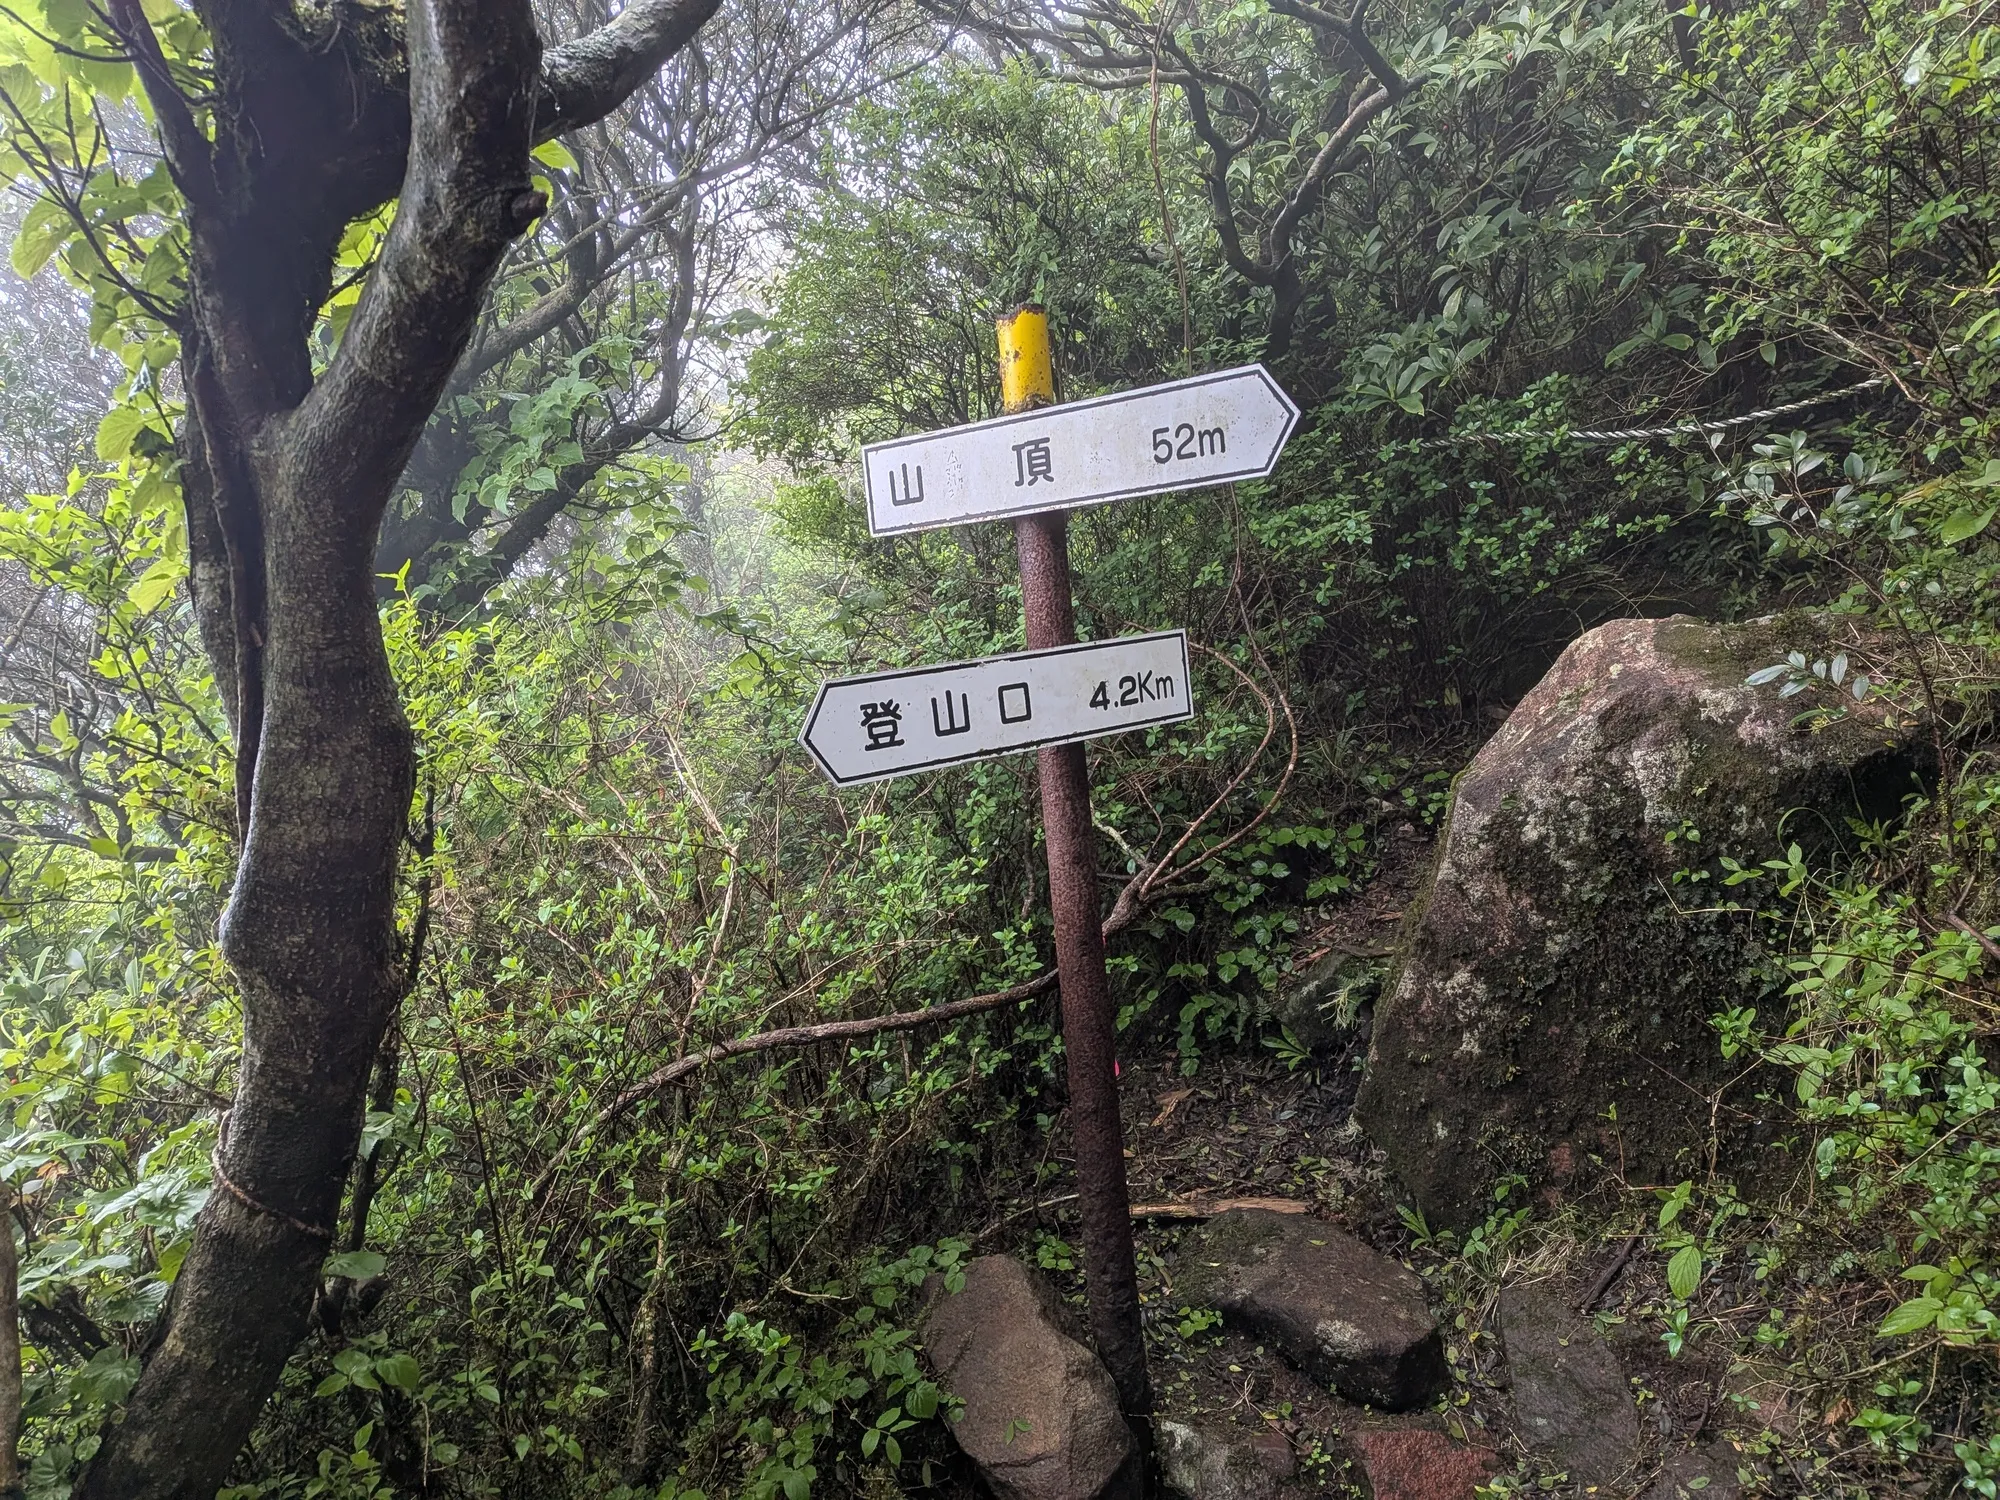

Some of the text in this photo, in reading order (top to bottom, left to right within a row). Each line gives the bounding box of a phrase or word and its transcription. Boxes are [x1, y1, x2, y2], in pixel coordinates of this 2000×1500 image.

[1152, 422, 1226, 465] 52m
[859, 669, 1175, 752] 登山口 4.2Km
